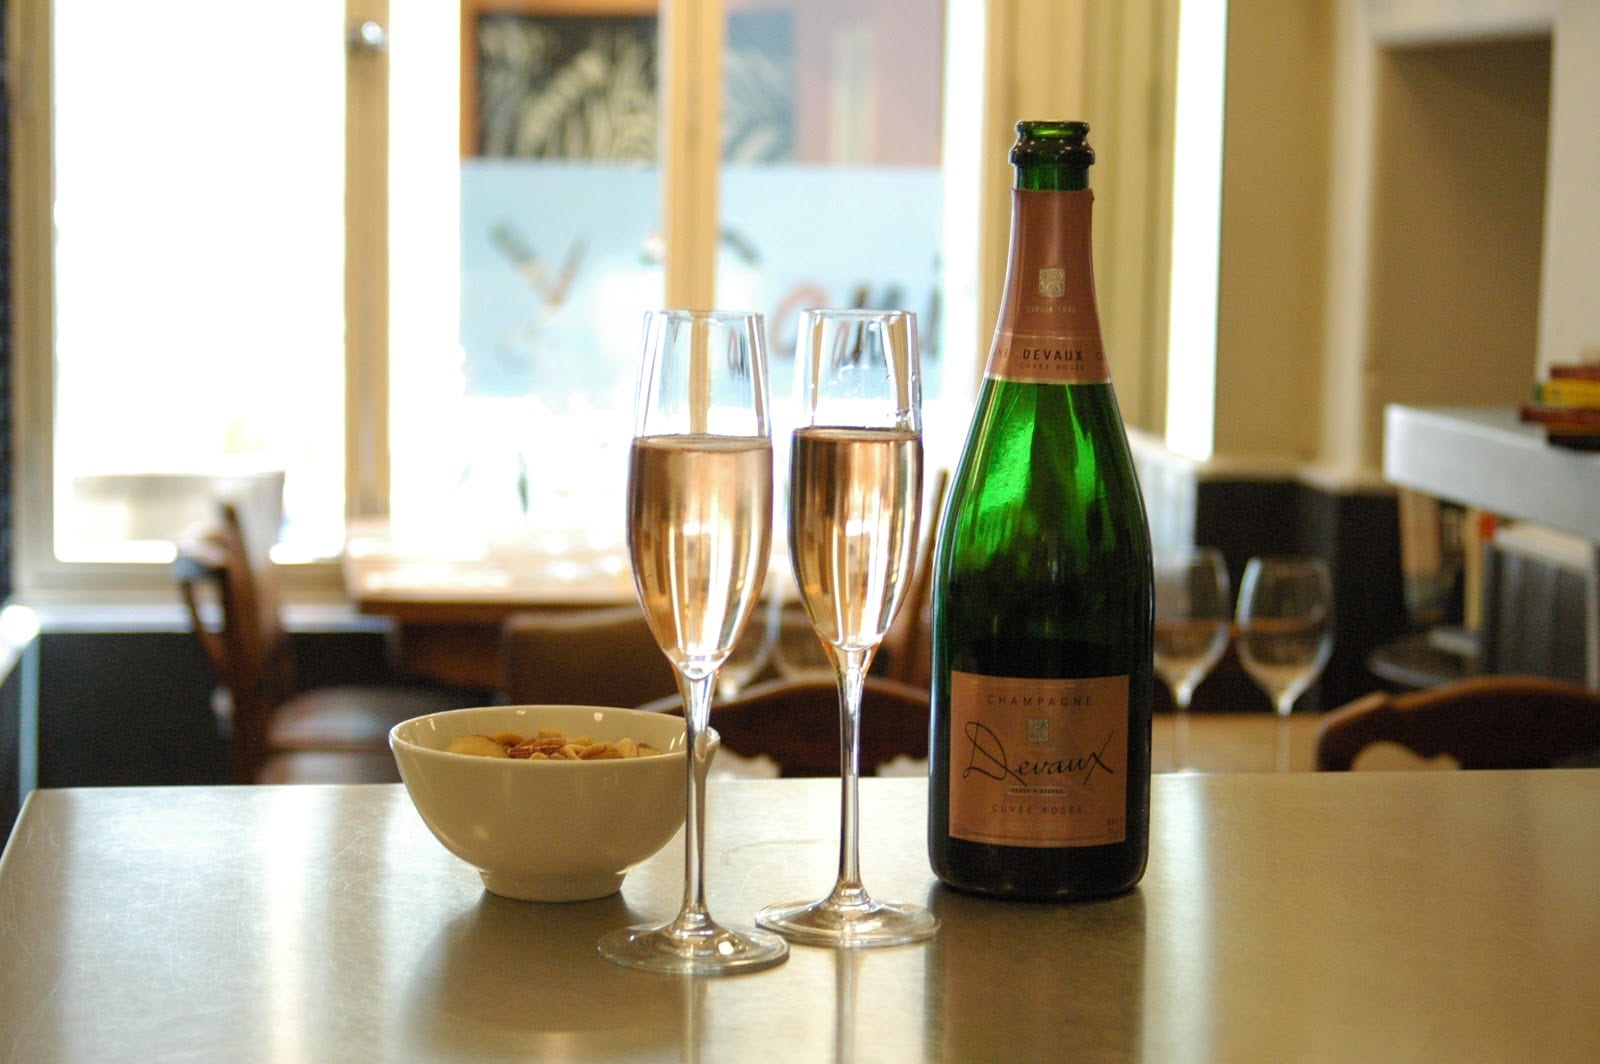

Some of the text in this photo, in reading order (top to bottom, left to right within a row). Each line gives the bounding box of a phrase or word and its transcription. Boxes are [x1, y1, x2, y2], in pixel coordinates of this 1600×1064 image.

[1023, 348, 1082, 361] DEVAUX
[987, 694, 1092, 707] CHAMPAGNE
[962, 720, 1115, 787] Devaux
[991, 803, 1032, 814] CUVÉE
